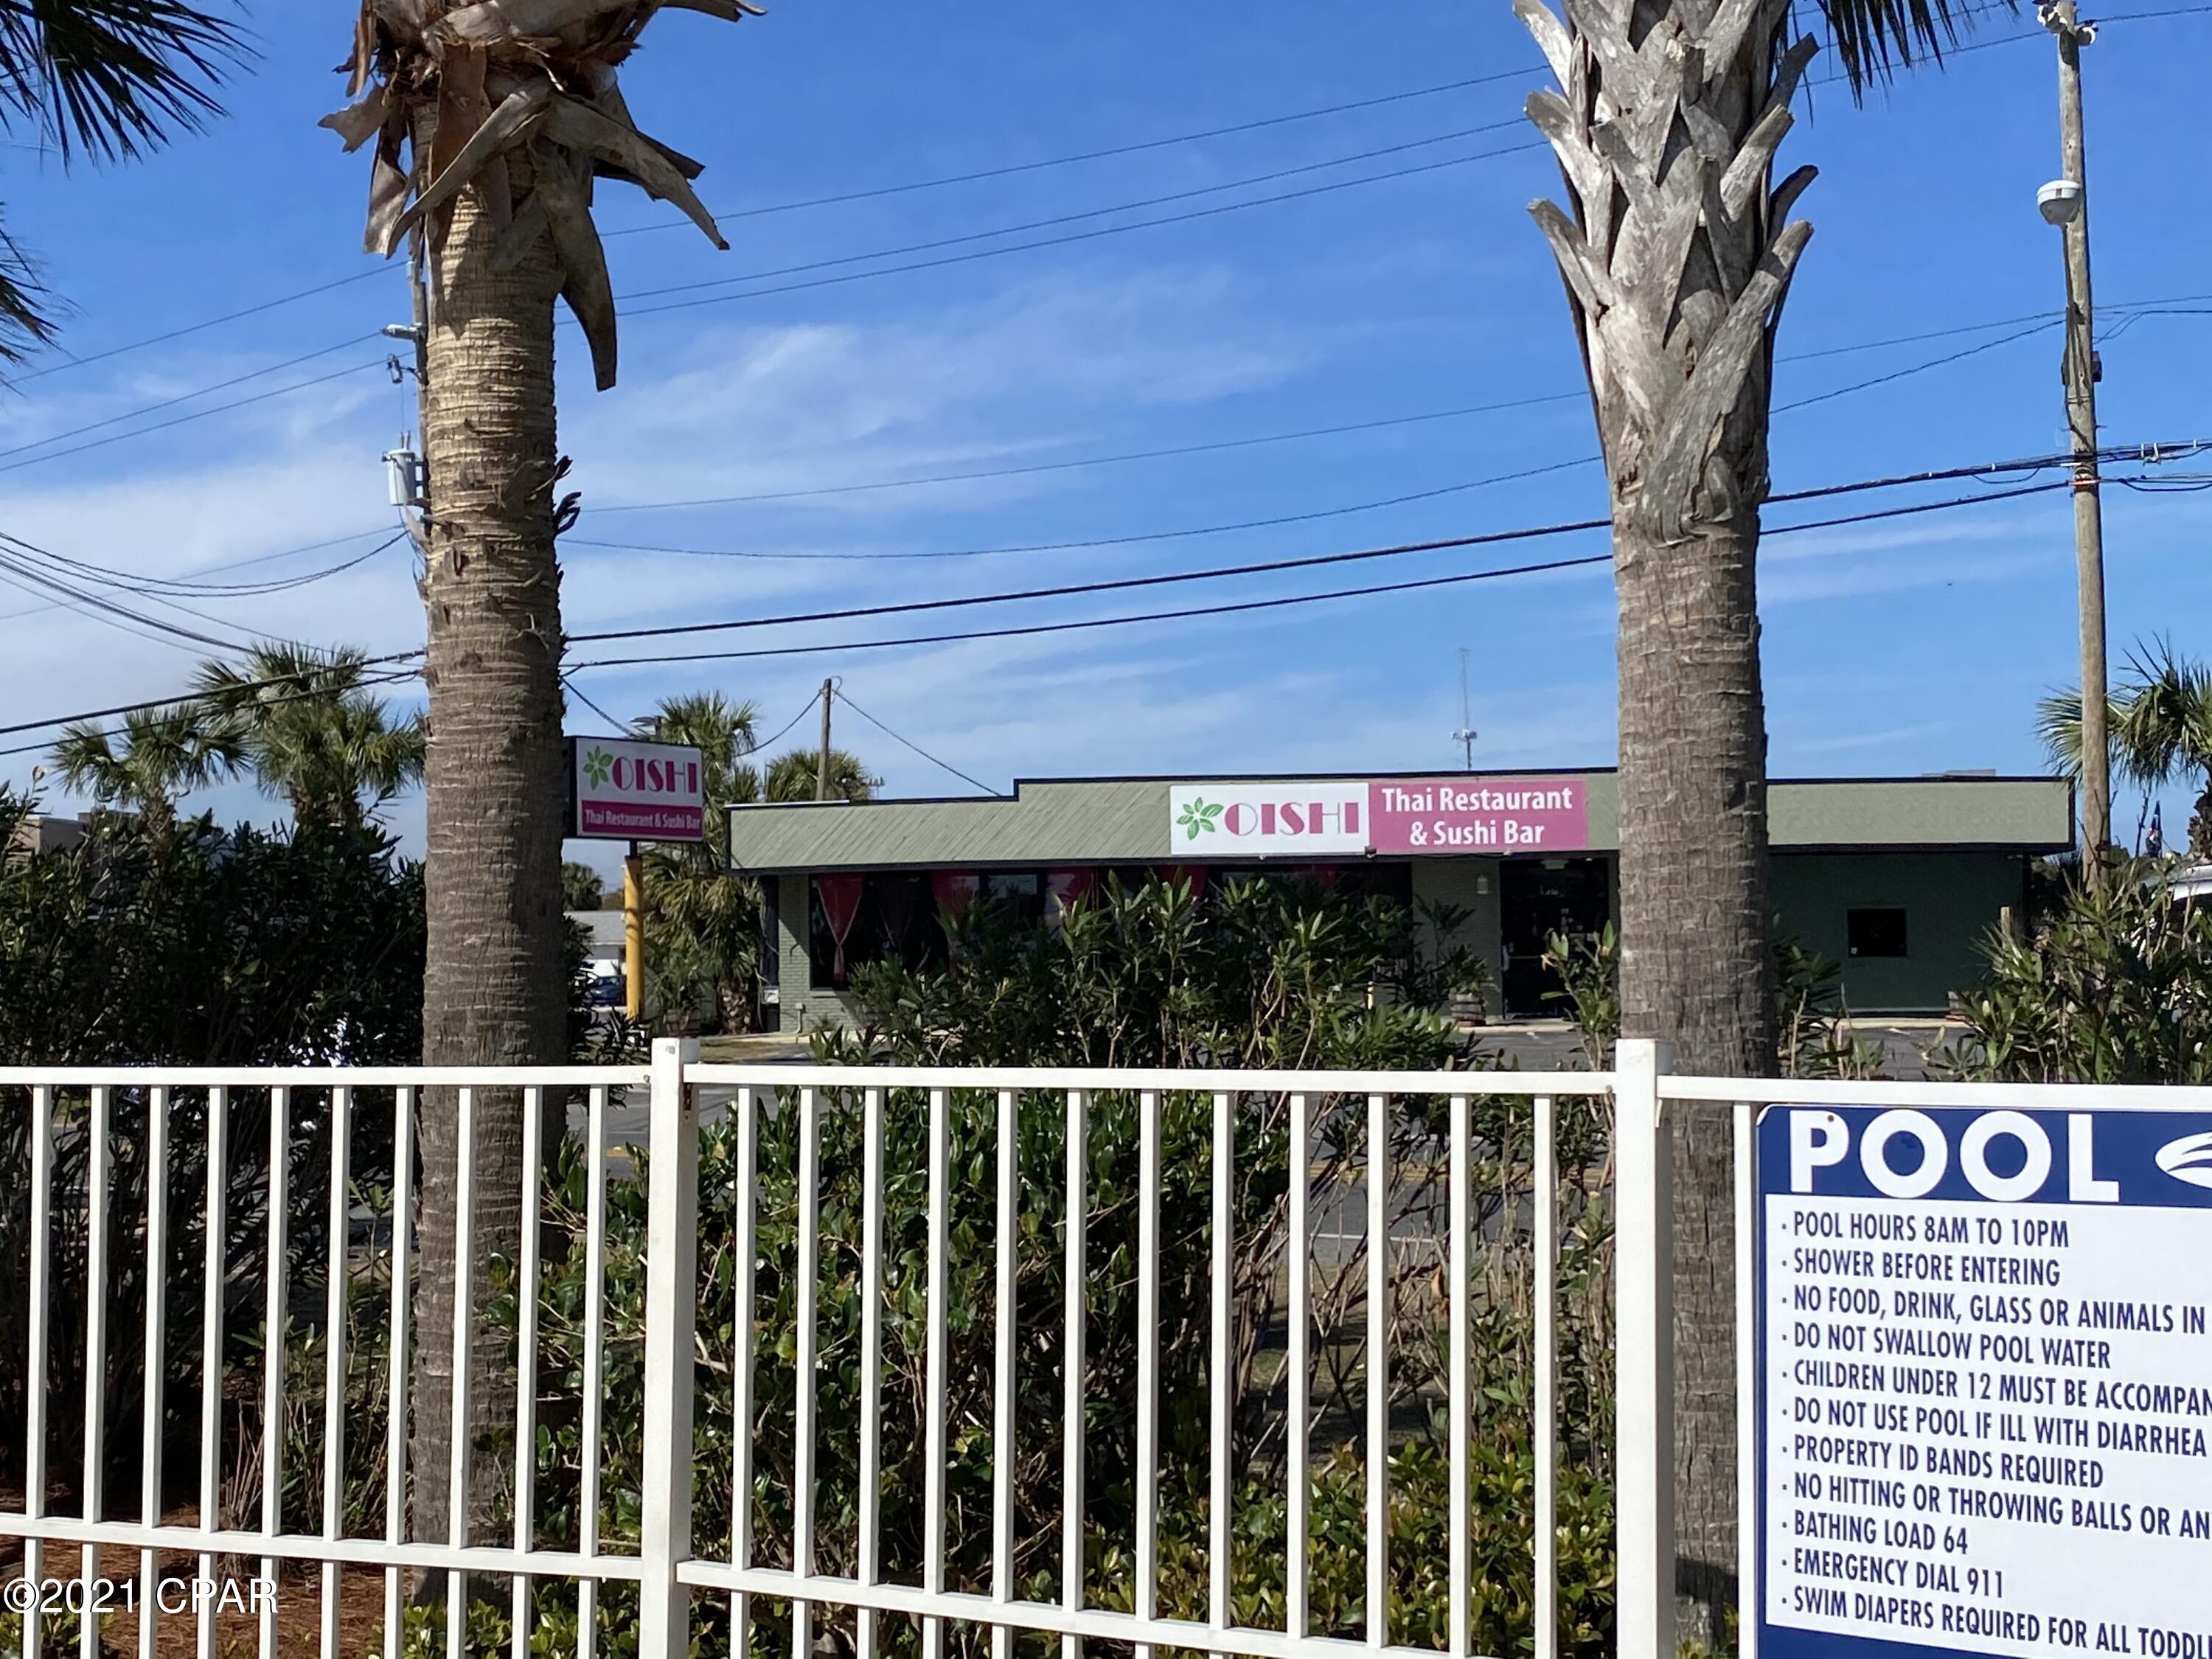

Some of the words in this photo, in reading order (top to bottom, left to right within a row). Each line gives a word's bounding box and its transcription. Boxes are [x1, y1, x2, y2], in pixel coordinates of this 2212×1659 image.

[612, 757, 698, 793] OISHI
[585, 810, 604, 824] Thai
[605, 810, 653, 827] Restaurant
[654, 813, 661, 827] &
[664, 814, 685, 828] Sushi
[686, 815, 700, 829] Bar
[1224, 802, 1359, 836] OISHI
[1382, 787, 1433, 812] Thai
[1440, 787, 1573, 811] Restaurant
[1410, 821, 1428, 846] &
[1434, 820, 1497, 845] Sushi
[1504, 820, 1545, 844] Bar
[1790, 1109, 2120, 1203] POOL
[1795, 1211, 1843, 1237] POOL
[1851, 1214, 1916, 1241] HOURS
[1925, 1216, 1968, 1243] 8AM
[1977, 1218, 2001, 1245] TO
[2012, 1220, 2068, 1247] 10PM
[1795, 1248, 1874, 1277] SHOWER
[1883, 1253, 1952, 1281] BEFORE
[1962, 1256, 2059, 1287] ENTERING
[1795, 1285, 1820, 1311] NO
[1829, 1287, 1885, 1320] FOOD,
[1895, 1291, 1961, 1324] DRINK,
[1970, 1295, 2031, 1324] GLASS
[2040, 1298, 2068, 1326] OR
[2078, 1301, 2173, 1332] ANIMALS
[2183, 1306, 2205, 1334] IN
[1795, 1322, 1820, 1348] DO
[1829, 1324, 1865, 1352] NOT
[1874, 1327, 1972, 1359] SWALLOW
[1980, 1335, 2034, 1363] POOL
[2041, 1338, 2110, 1368] WATER
[1795, 1360, 1884, 1391] CHILDREN
[1893, 1367, 1957, 1397] UNDER
[1969, 1372, 1990, 1399] 12
[2000, 1374, 2056, 1405] MUST
[2065, 1379, 2087, 1407] BE
[1795, 1397, 1820, 1423] DO
[1829, 1399, 1866, 1427] NOT
[1874, 1404, 1907, 1432] USE
[1916, 1407, 1968, 1437] POOL
[1976, 1412, 1992, 1439] IF
[2000, 1414, 2026, 1441] ILL
[2034, 1416, 2088, 1447] WITH
[2098, 1422, 2206, 1457] DIARRHEA
[1795, 1434, 1891, 1468] PROPERTY
[1900, 1444, 1918, 1470] ID
[1927, 1447, 1992, 1478] BANDS
[2002, 1453, 2103, 1488] REQUIRED
[1795, 1472, 1821, 1499] NO
[1830, 1475, 1905, 1509] HITTING
[1913, 1484, 1940, 1512] OR
[1949, 1487, 2063, 1524] THROWING
[2072, 1499, 2131, 1531] BALLS
[2140, 1506, 2170, 1535] OR
[2180, 1510, 2212, 1540] AN
[1795, 1510, 1876, 1543] BATHING
[1885, 1520, 1935, 1550] LOAD
[1944, 1526, 1967, 1554] 64
[1795, 1548, 1908, 1586] EMERGENCY
[1916, 1562, 1959, 1593] DIAL
[1968, 1568, 2002, 1598] 911
[1795, 1586, 1847, 1620] SWIM
[1855, 1593, 1933, 1628] DIAPERS
[1942, 1604, 2039, 1641] REQUIRED
[2049, 1617, 2087, 1648] FOR
[2096, 1623, 2130, 1653] ALL
